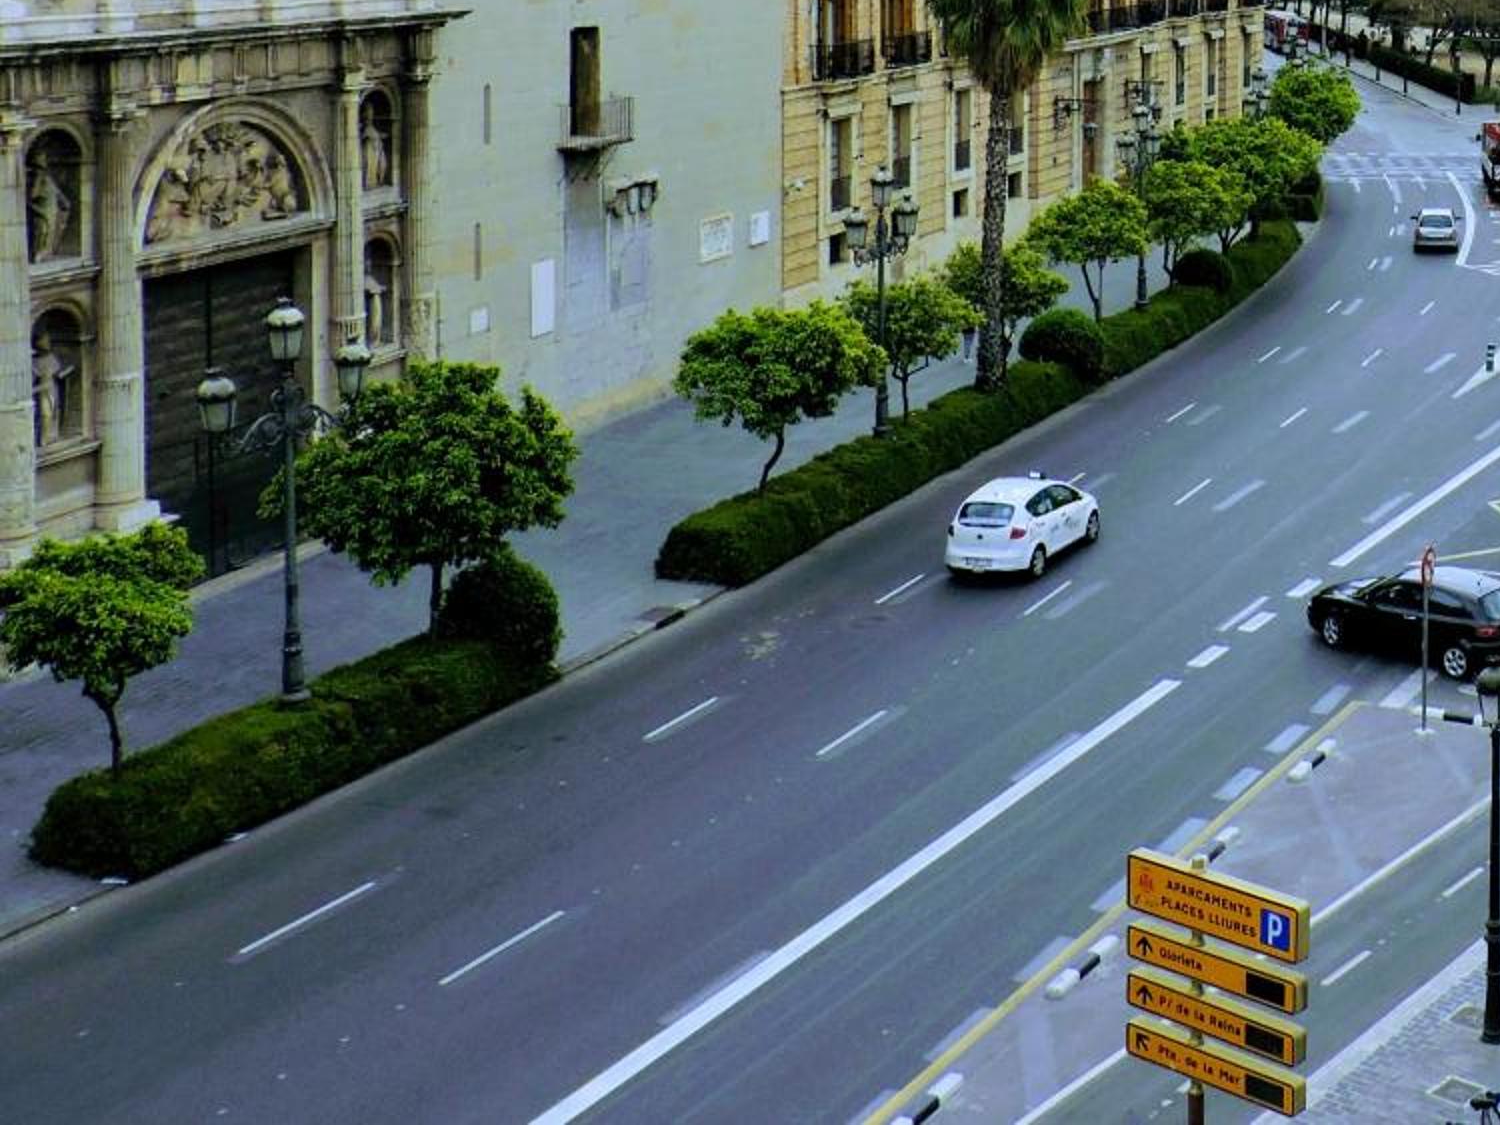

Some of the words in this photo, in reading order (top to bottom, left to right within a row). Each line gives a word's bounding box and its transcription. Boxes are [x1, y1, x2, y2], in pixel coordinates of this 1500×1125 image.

[1167, 880, 1253, 917] APARCAMENTS
[1160, 896, 1204, 920] PLACES
[1208, 912, 1257, 938] LLIURES
[1267, 912, 1283, 945] P
[1159, 947, 1203, 971] Glorieta
[1176, 1003, 1189, 1016] de
[1194, 1010, 1206, 1022] la
[1209, 1015, 1241, 1036] Reina
[1185, 1054, 1198, 1069] de
[1203, 1061, 1215, 1075] la
